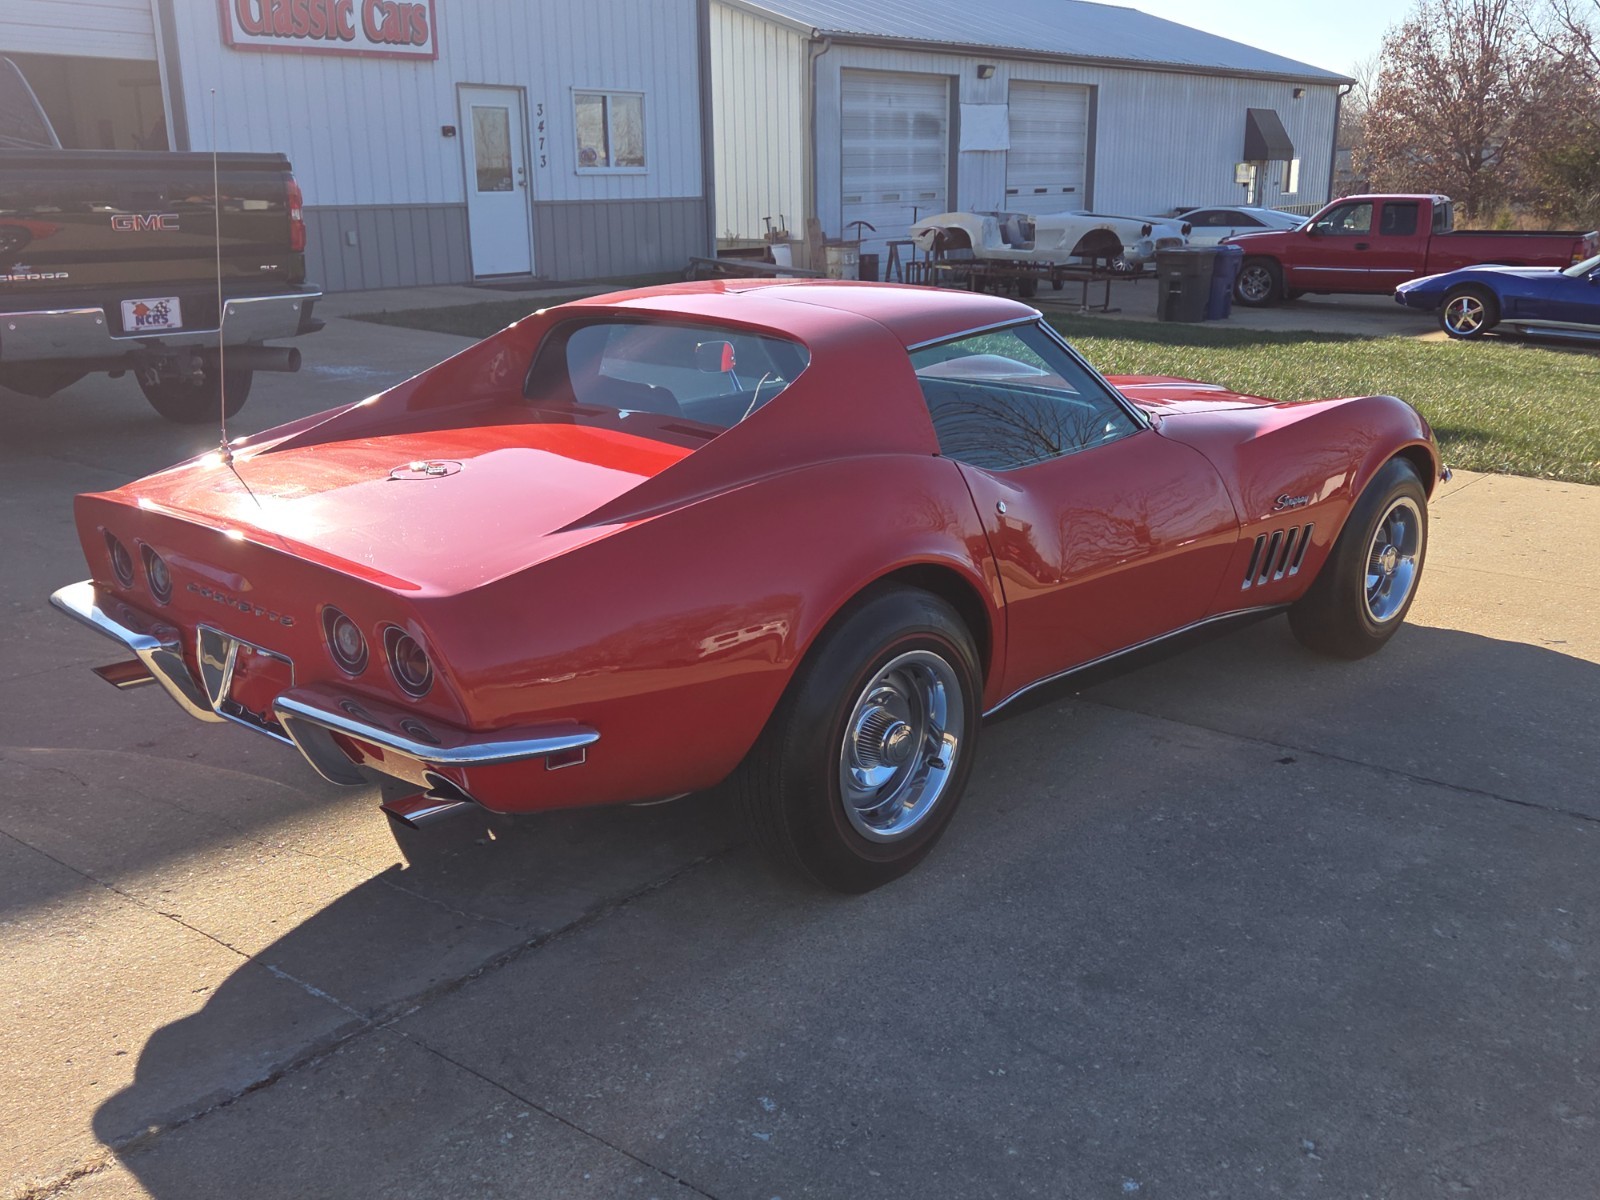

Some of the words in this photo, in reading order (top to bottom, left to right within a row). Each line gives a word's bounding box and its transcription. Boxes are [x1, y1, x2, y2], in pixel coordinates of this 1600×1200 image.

[235, 0, 356, 42] Classic
[361, 0, 429, 46] Cars
[112, 213, 180, 231] GMC
[136, 314, 169, 326] NCRS
